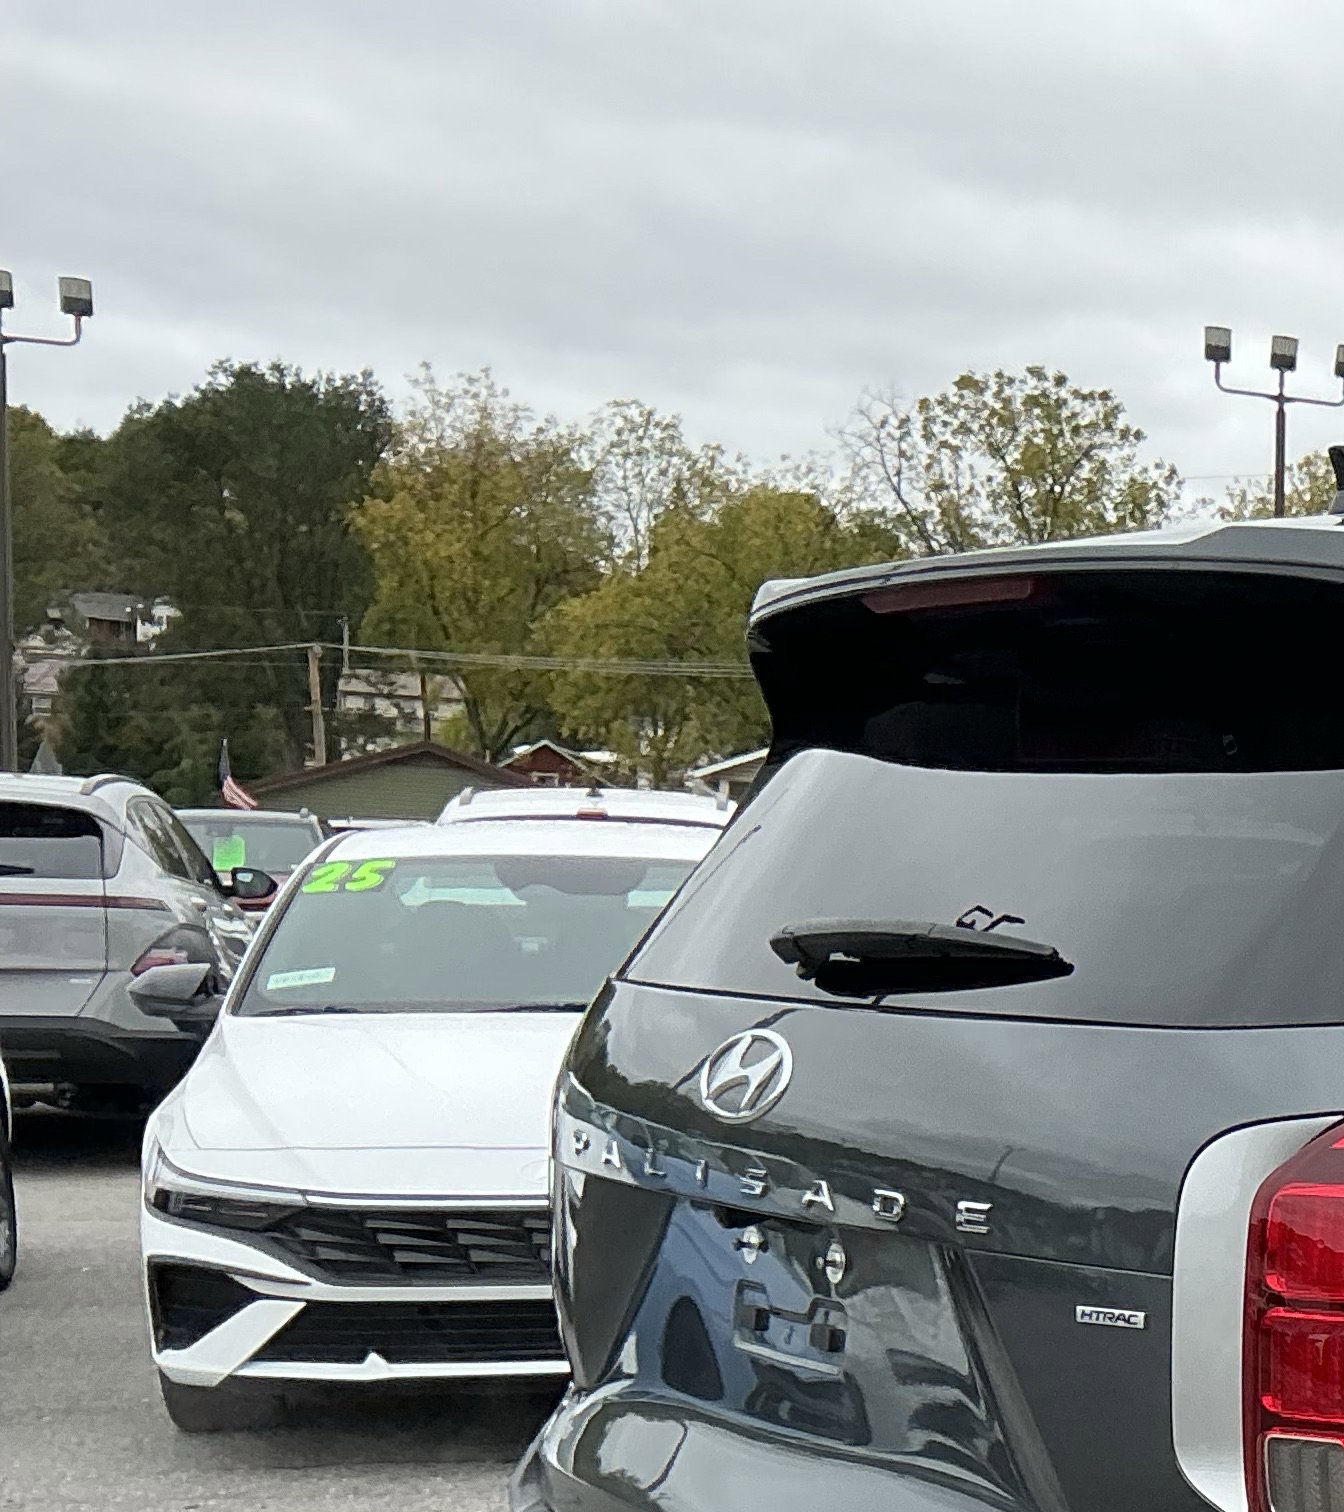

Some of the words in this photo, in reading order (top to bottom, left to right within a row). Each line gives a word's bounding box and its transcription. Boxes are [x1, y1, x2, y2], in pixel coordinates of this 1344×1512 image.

[301, 860, 396, 894] 25
[572, 1129, 994, 1236] PALISADE
[1079, 1308, 1139, 1326] HTRAC
